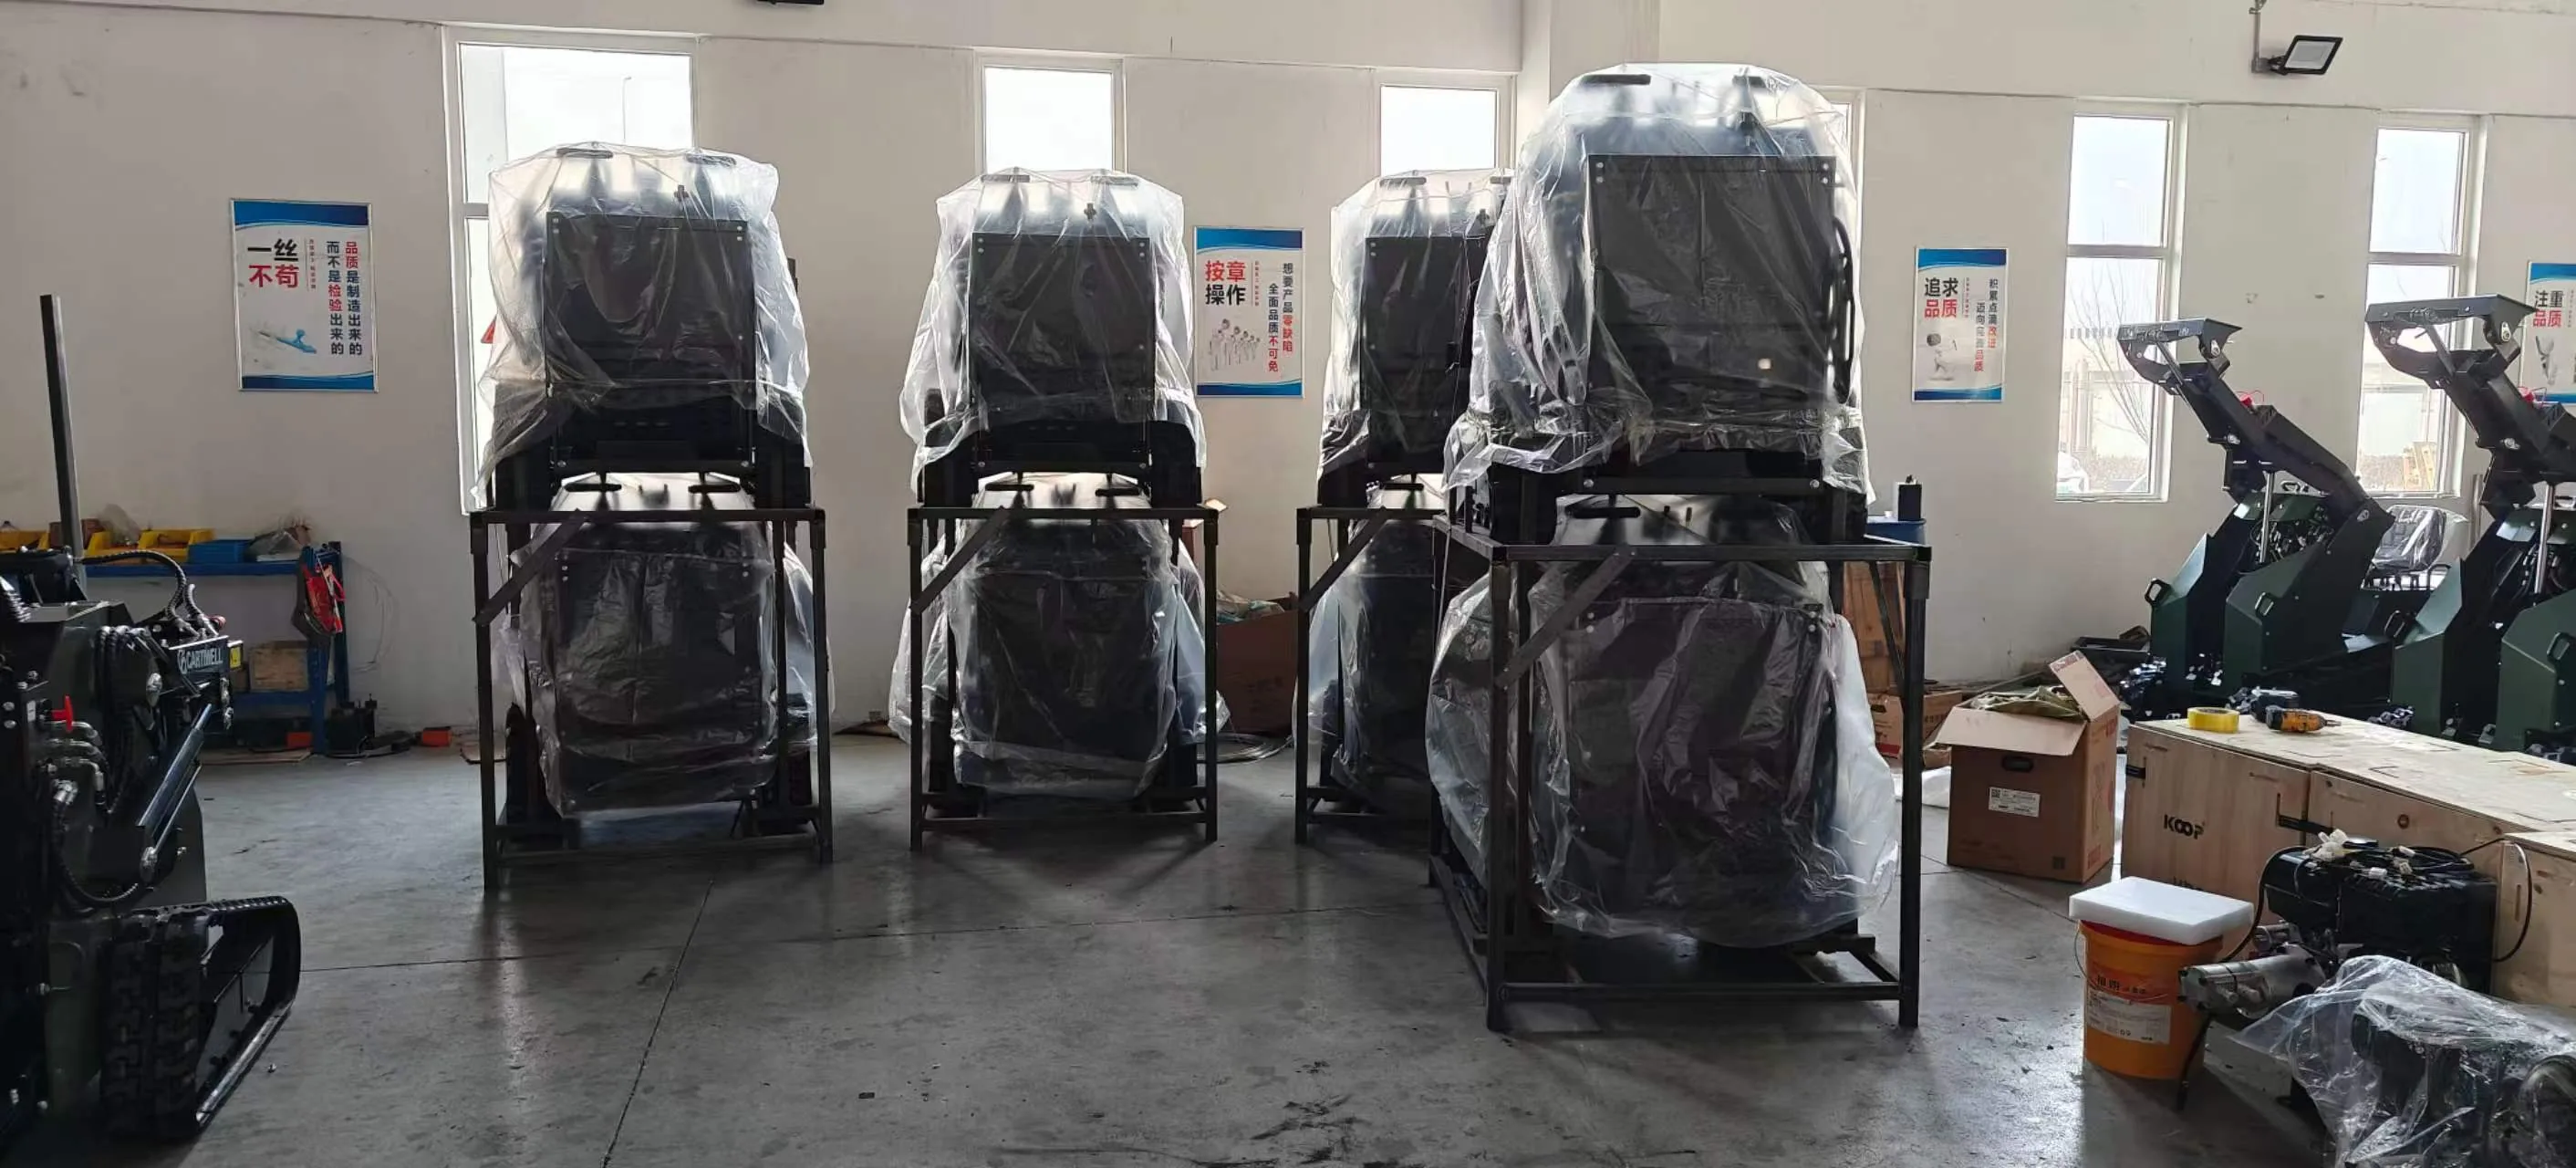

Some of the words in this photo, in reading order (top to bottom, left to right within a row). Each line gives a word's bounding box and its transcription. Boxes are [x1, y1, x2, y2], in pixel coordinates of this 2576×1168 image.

[247, 238, 298, 262] 一丝
[248, 264, 299, 288] 不苟
[1205, 260, 1246, 282] 按章
[326, 241, 344, 355] 而不是检验出来的
[345, 241, 363, 355] 品质是制造出来的
[1205, 284, 1246, 306] 操作
[1924, 276, 1958, 297] 追求
[2535, 289, 2564, 308] 注重
[1282, 262, 1293, 352] 想要产品零缺陷
[1924, 298, 1958, 318] 品质
[2532, 310, 2562, 328] 品质
[1268, 283, 1279, 372] 全面品质不可免
[2163, 814, 2205, 840] KOOP
